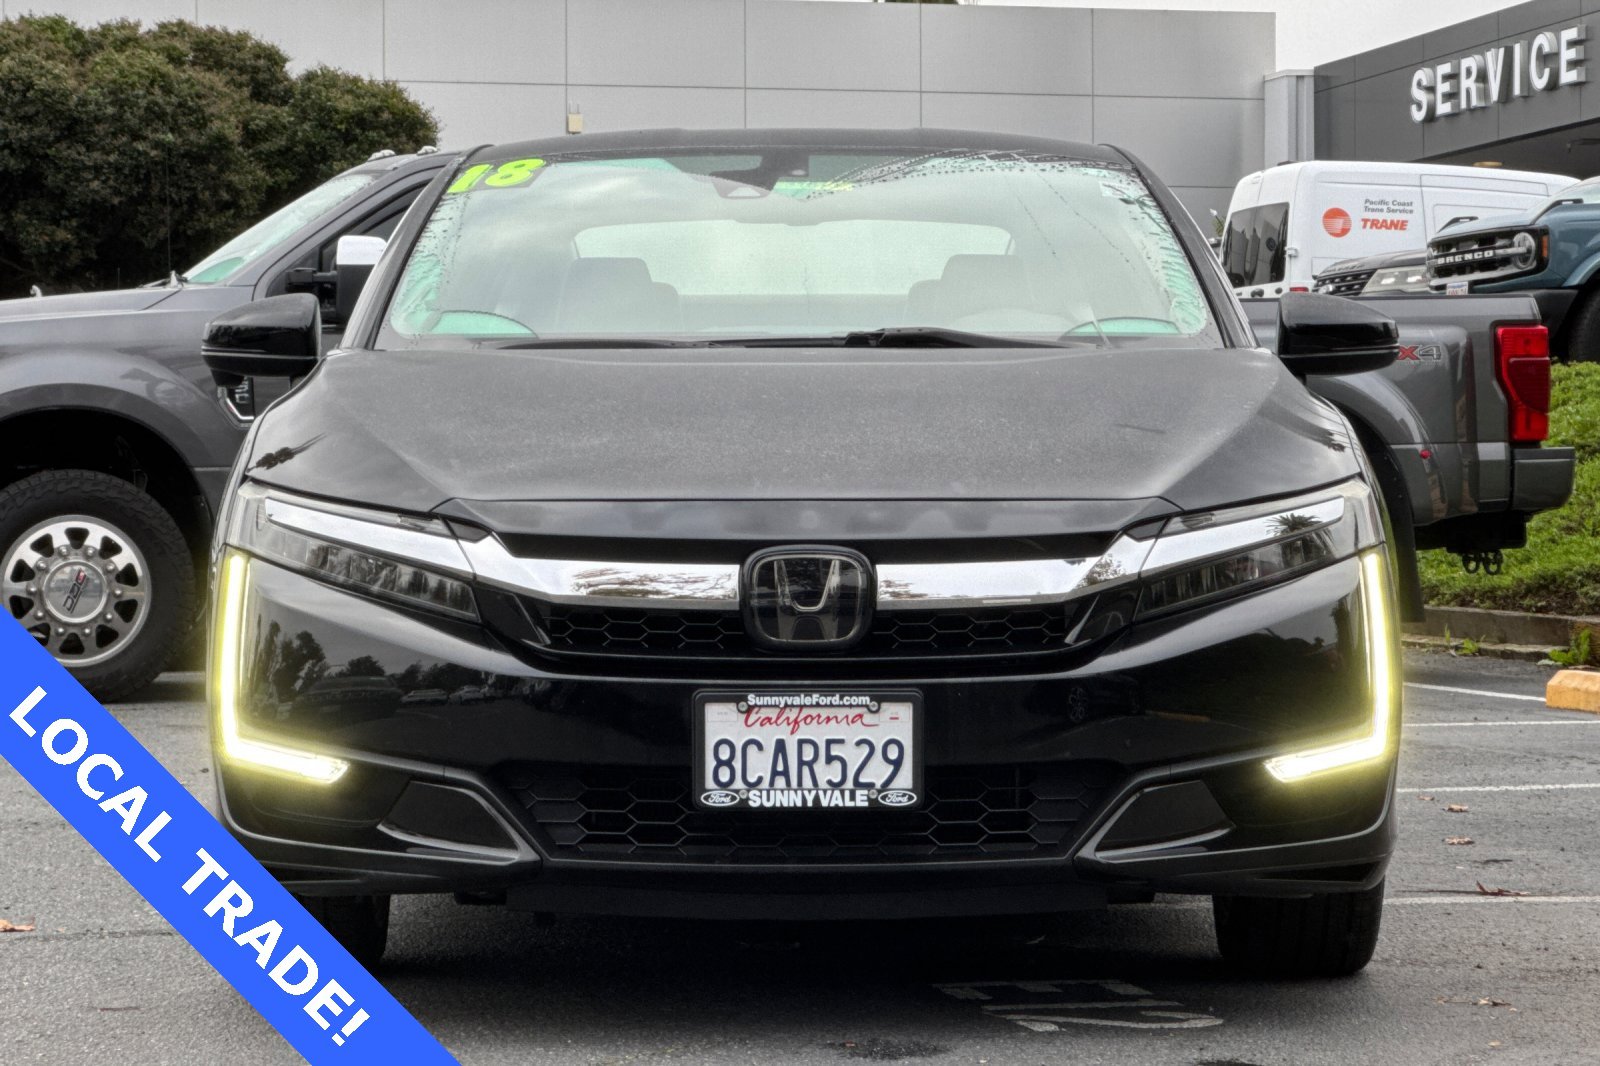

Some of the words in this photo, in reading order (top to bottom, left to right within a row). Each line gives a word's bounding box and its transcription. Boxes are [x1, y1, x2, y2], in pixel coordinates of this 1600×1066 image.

[1410, 25, 1588, 124] SERVICE
[446, 158, 547, 194] 18
[1361, 218, 1409, 231] TRANE
[1437, 250, 1494, 265] BRONCO
[747, 694, 871, 707] SunnyvaleFord.com
[744, 708, 879, 736] California
[712, 738, 906, 788] 8CAR529
[748, 789, 869, 807] SUNNYVALE
